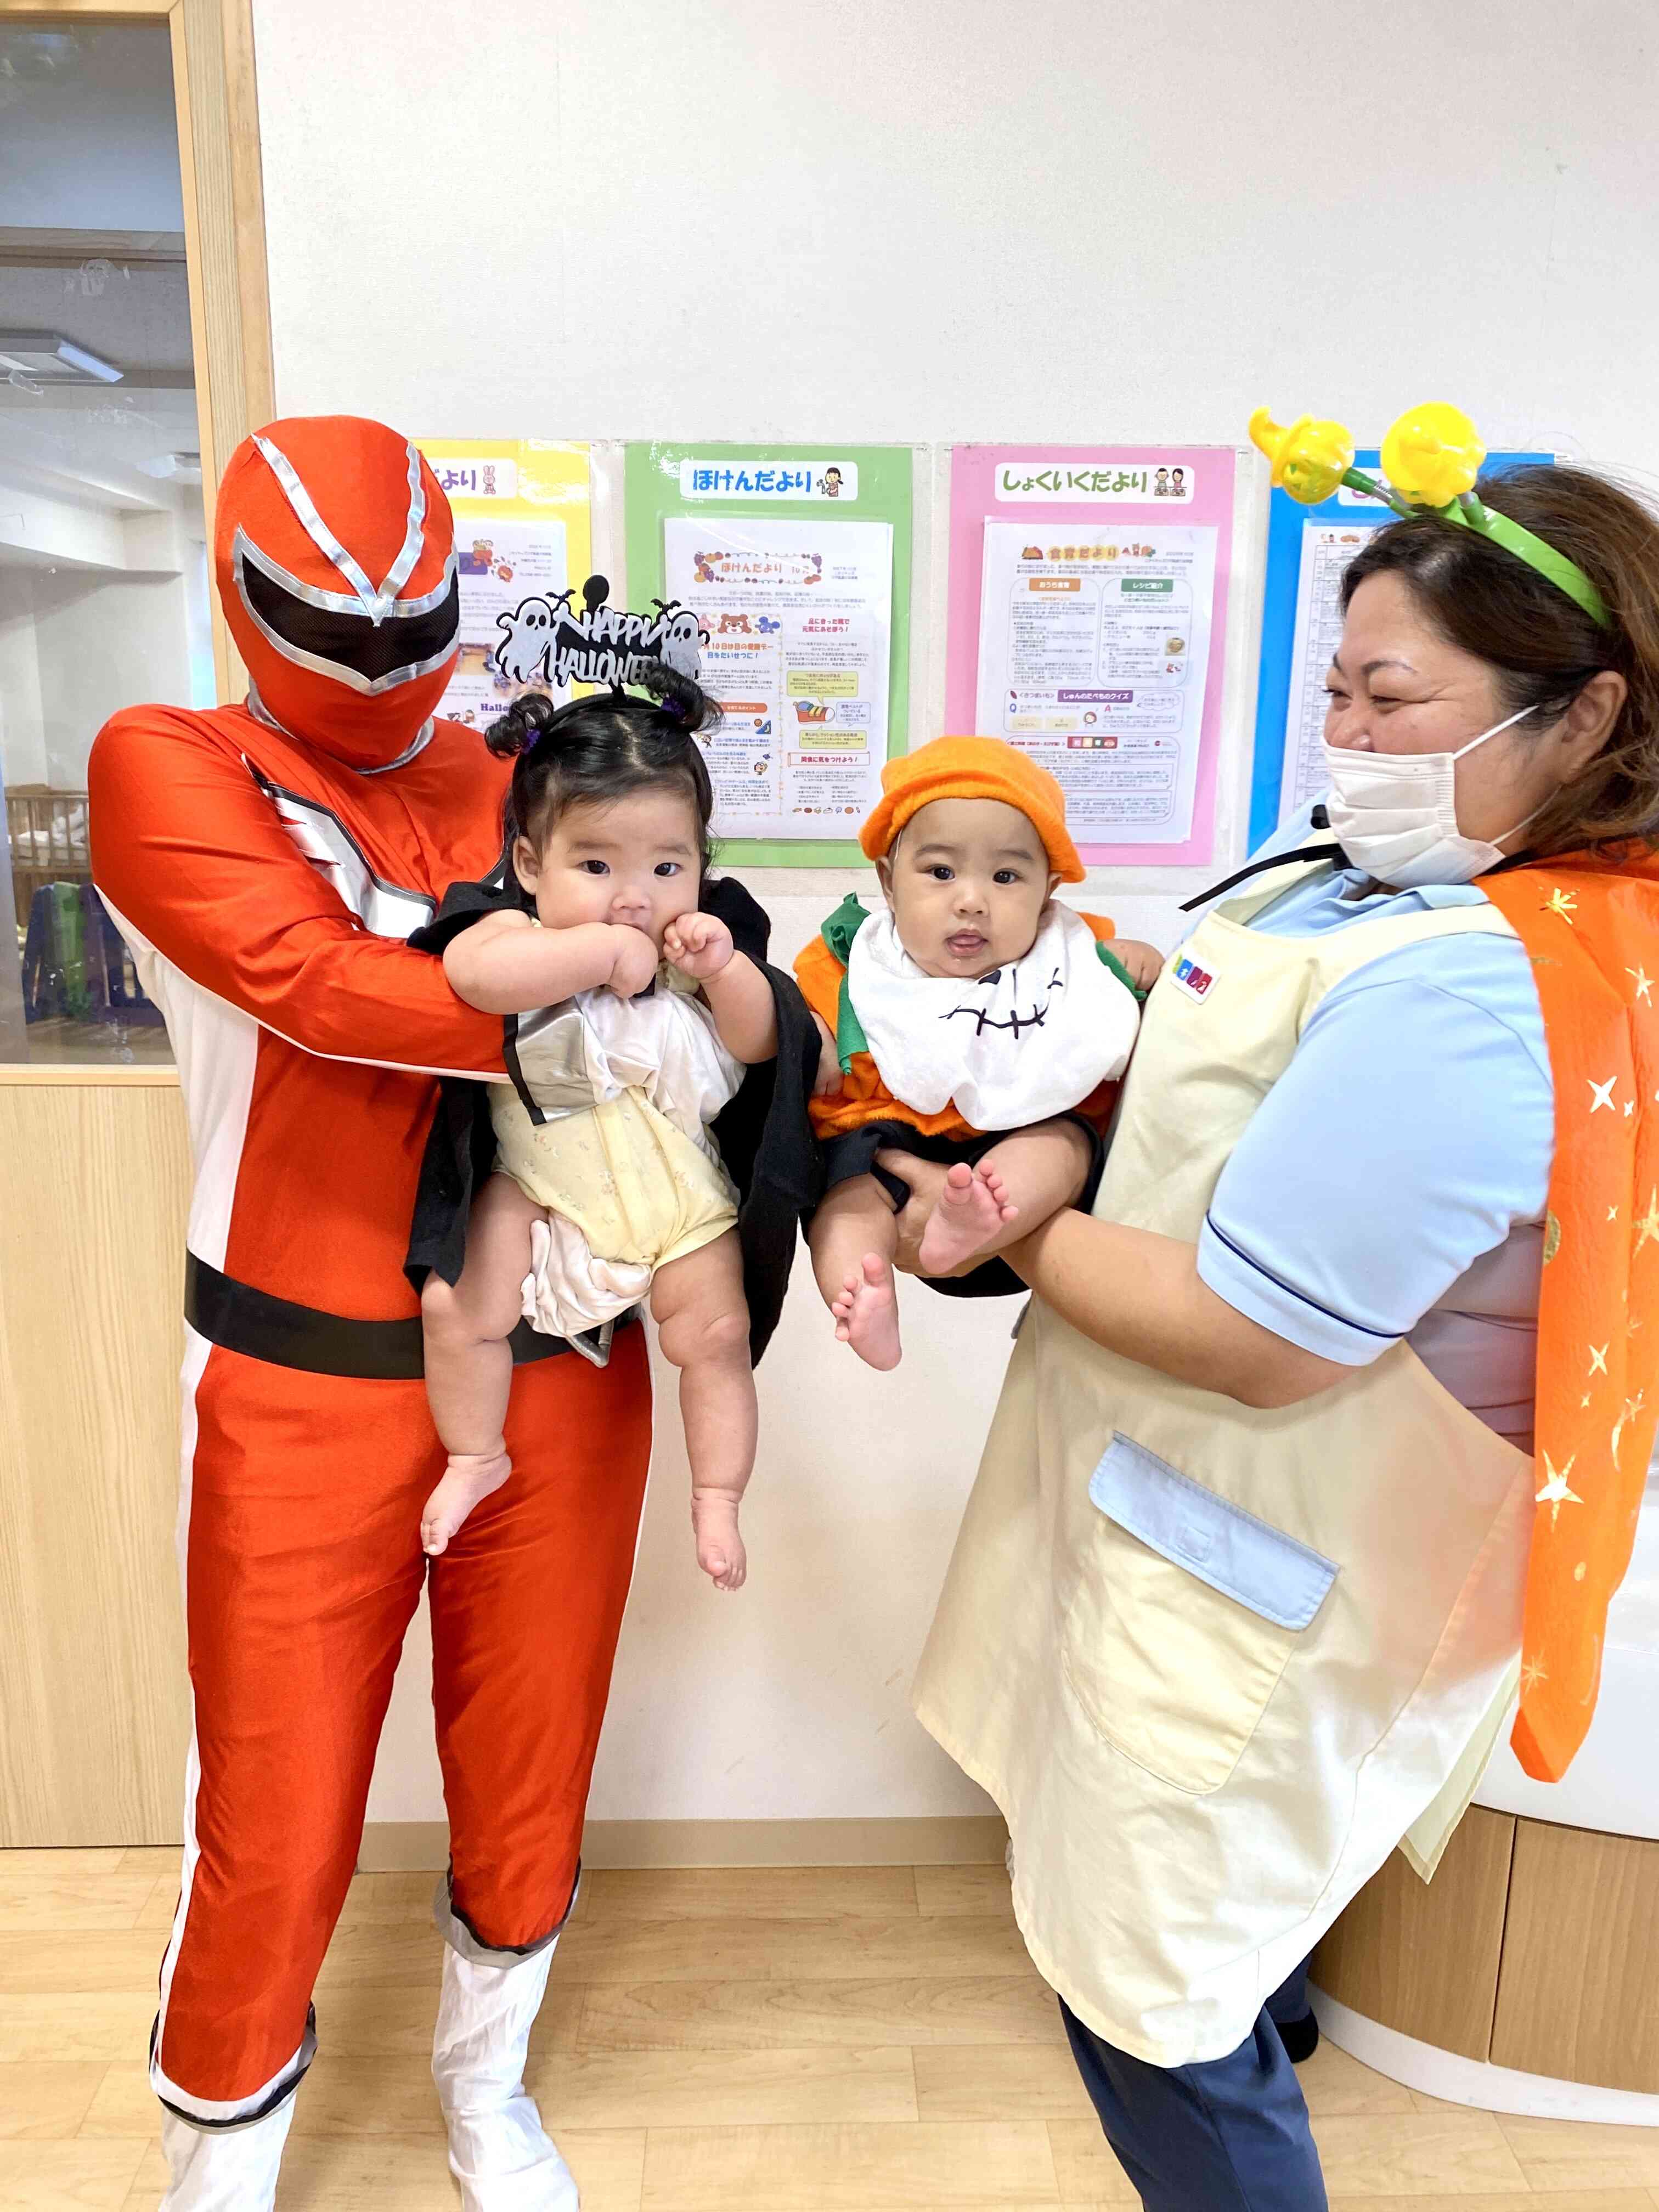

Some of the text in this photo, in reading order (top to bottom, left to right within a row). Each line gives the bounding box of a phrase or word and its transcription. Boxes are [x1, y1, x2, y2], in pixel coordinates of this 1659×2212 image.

[693, 469, 811, 492] ほけんだより
[1003, 470, 1147, 493] しょくいくだより
[721, 562, 782, 573] ほけんだより
[583, 607, 664, 647] HAPPY
